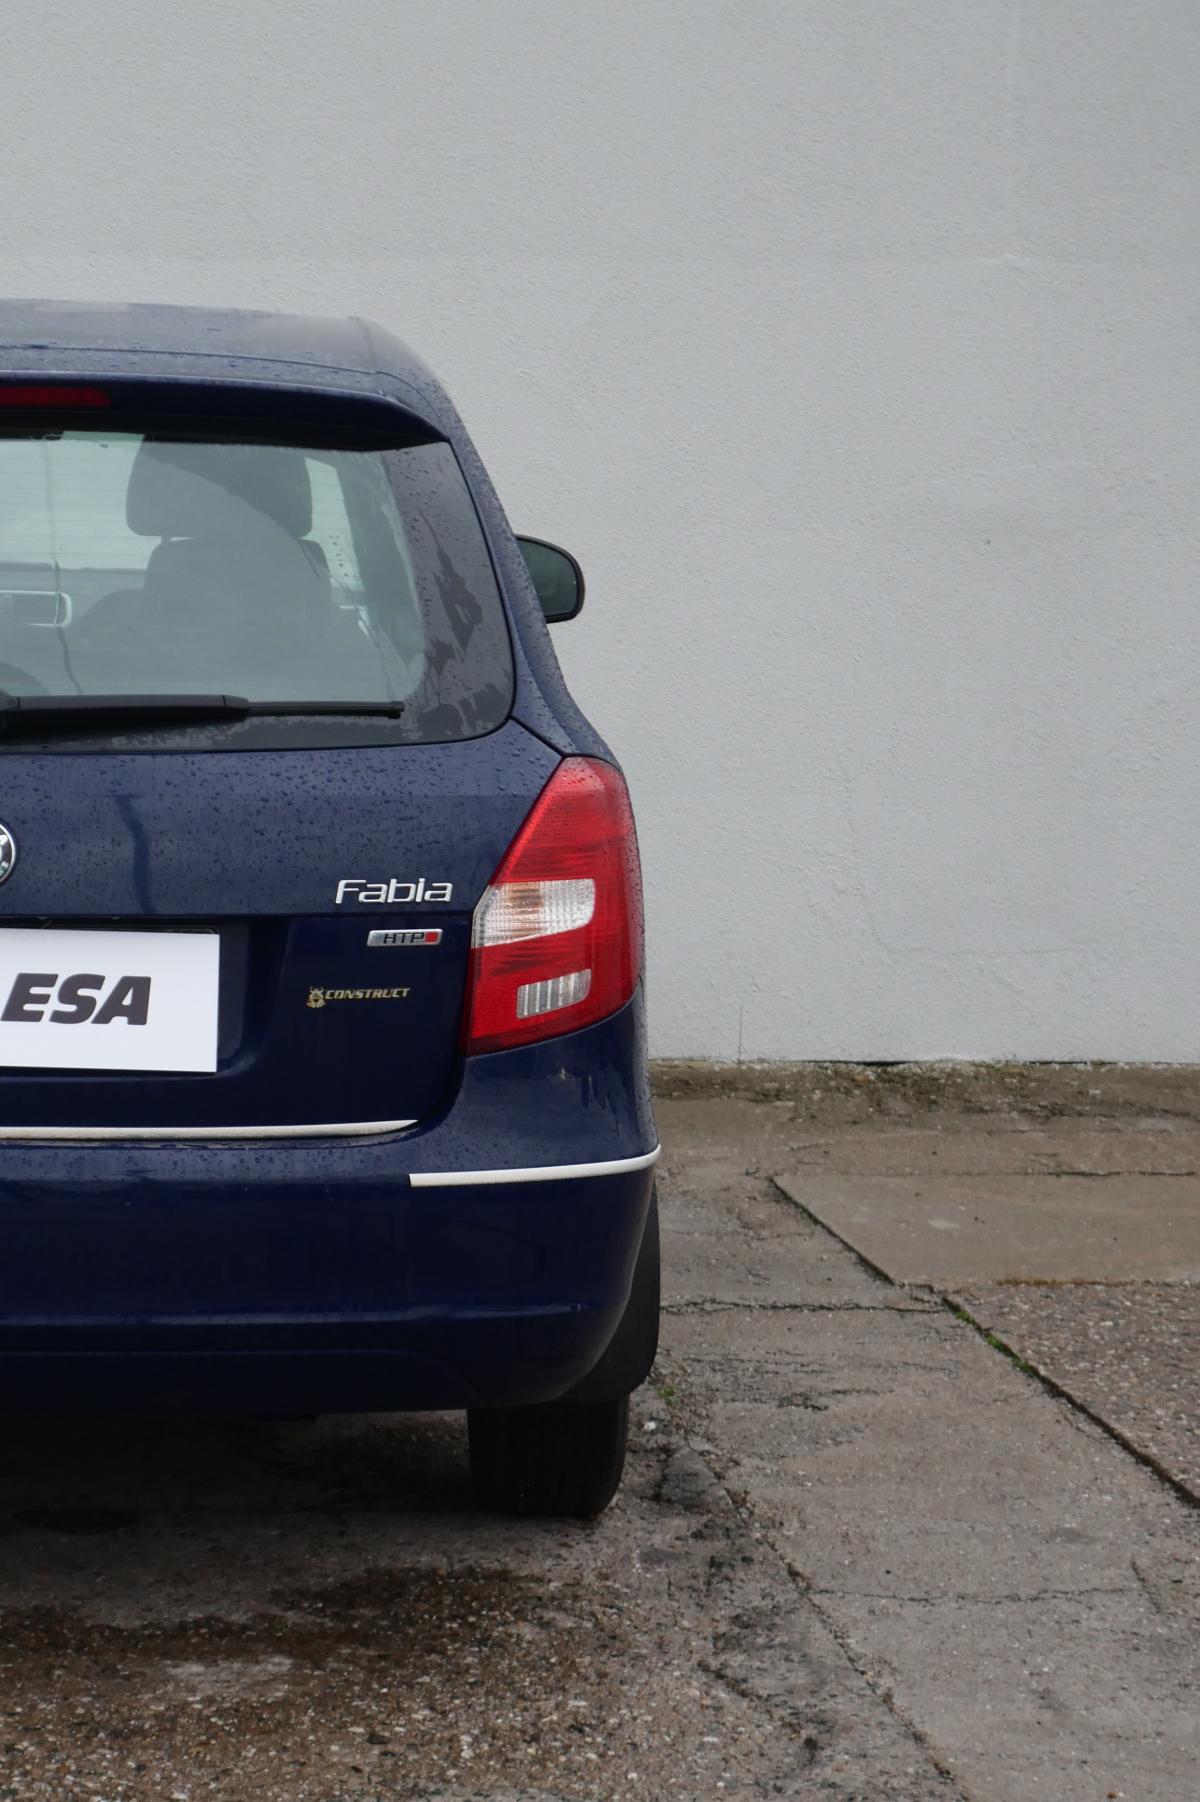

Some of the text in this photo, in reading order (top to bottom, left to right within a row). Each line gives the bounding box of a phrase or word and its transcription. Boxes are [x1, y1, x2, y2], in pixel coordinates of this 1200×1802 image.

[335, 877, 453, 904] Fabia
[383, 931, 425, 945] HTP
[0, 972, 152, 1026] ESA
[325, 987, 411, 1000] CONSTRUCT
